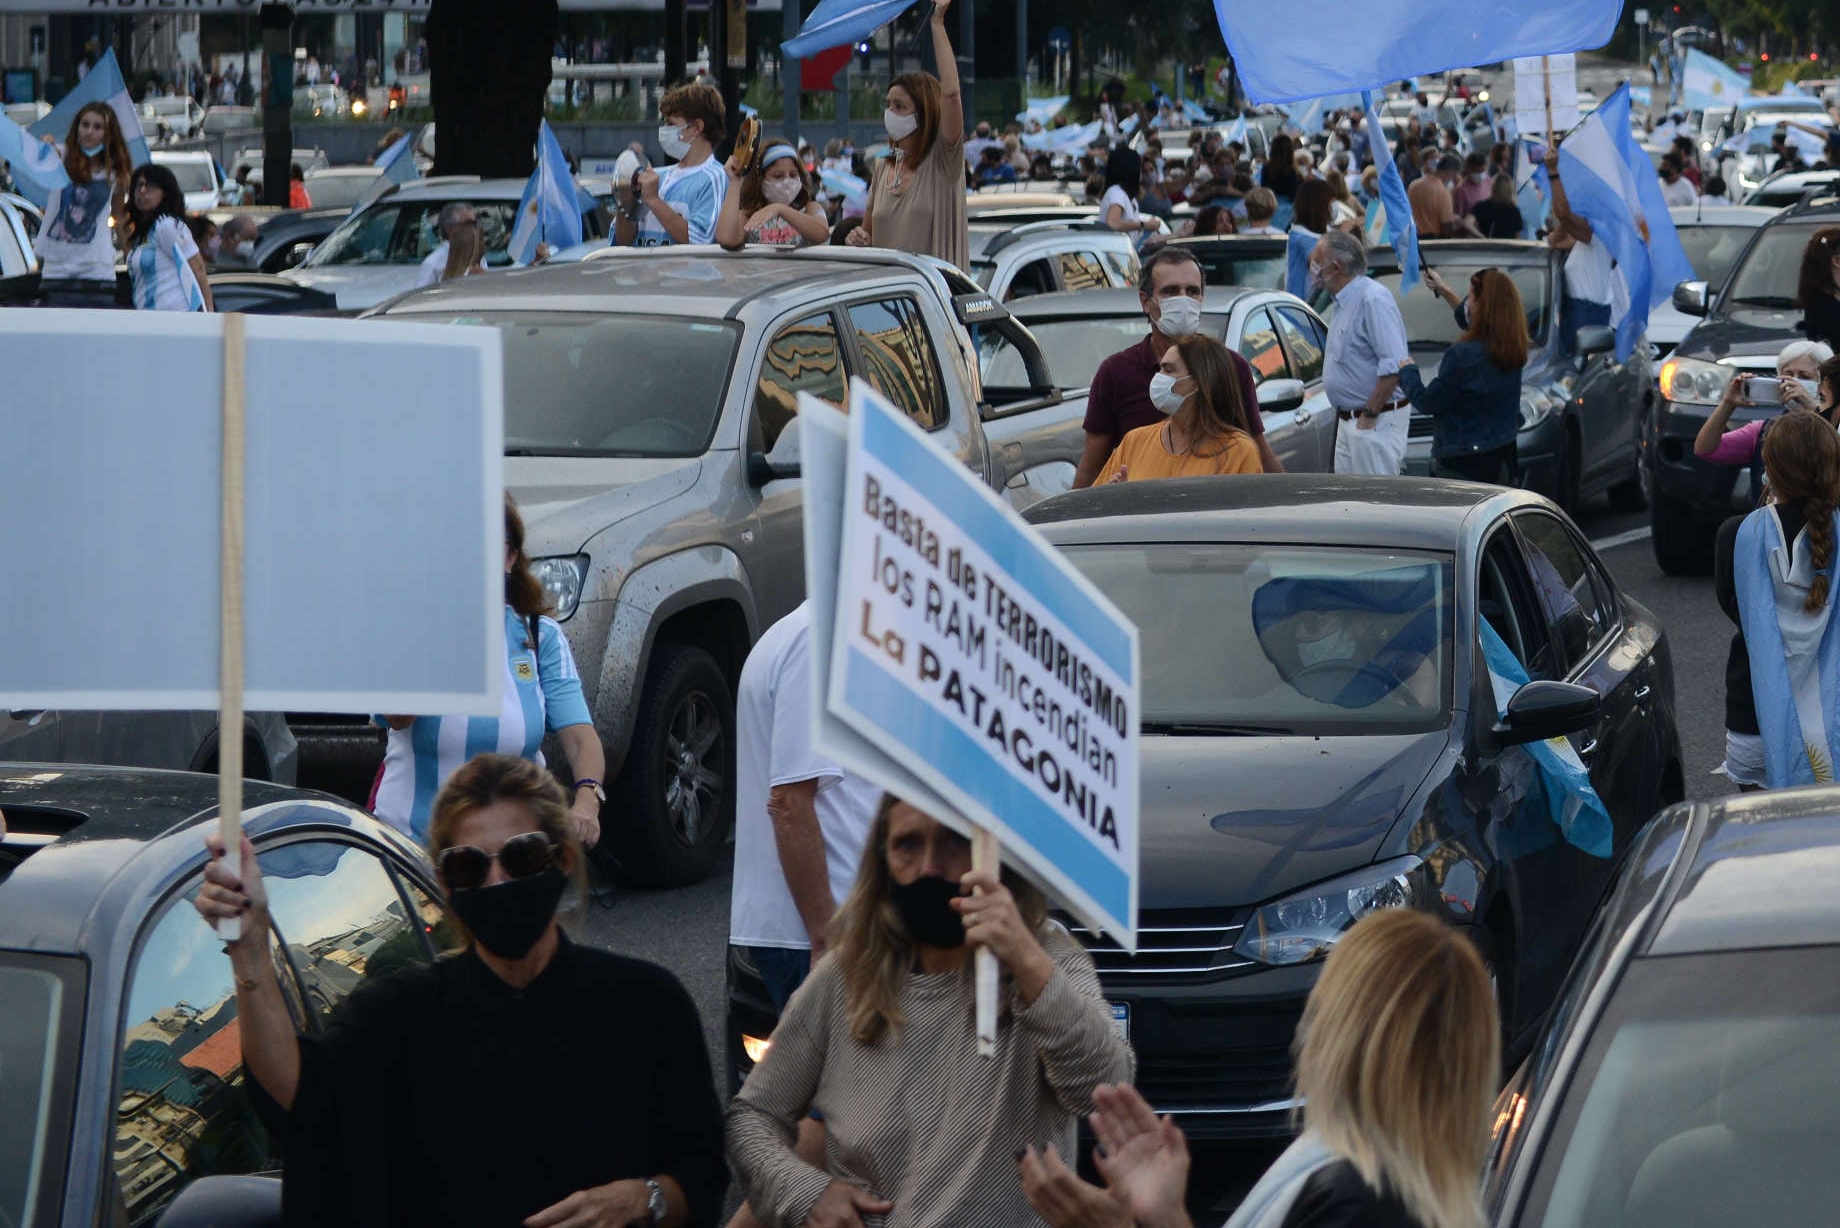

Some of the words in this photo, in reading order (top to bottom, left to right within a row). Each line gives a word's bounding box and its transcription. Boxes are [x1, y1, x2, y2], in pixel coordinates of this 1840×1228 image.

[860, 601, 905, 665] La
[918, 644, 1121, 852] PATAGONIA
[864, 474, 940, 569] Basta
[947, 546, 977, 601] de
[984, 575, 1128, 740] TERRORISMO
[872, 534, 914, 609] los
[925, 578, 986, 670] RAM
[994, 634, 1118, 789] incendian
